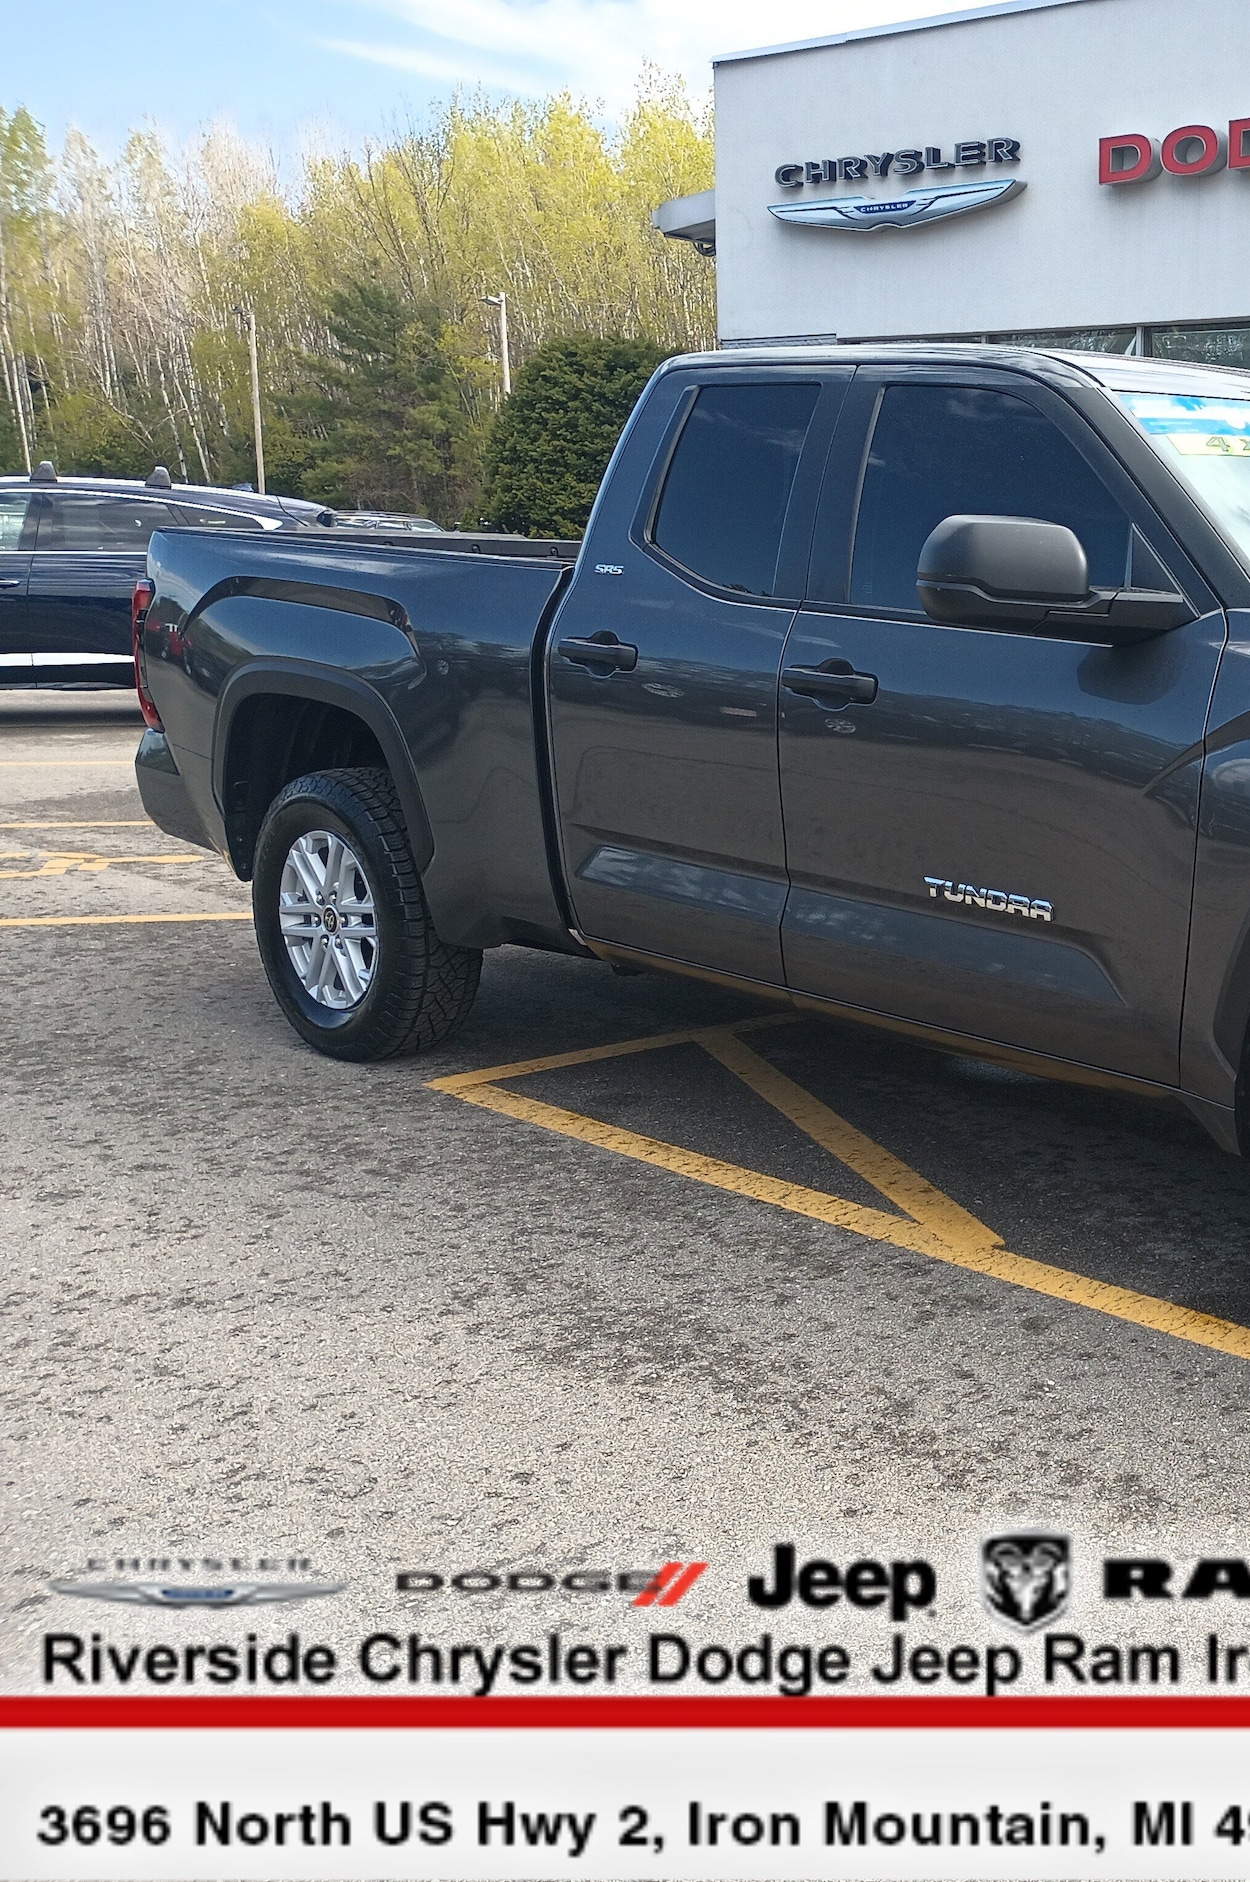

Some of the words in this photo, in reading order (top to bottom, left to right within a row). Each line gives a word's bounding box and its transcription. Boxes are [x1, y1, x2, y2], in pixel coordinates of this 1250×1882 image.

[774, 137, 1021, 188] CHRYSLER
[860, 203, 908, 212] CHRYSLER
[923, 876, 1055, 922] TUNDRA
